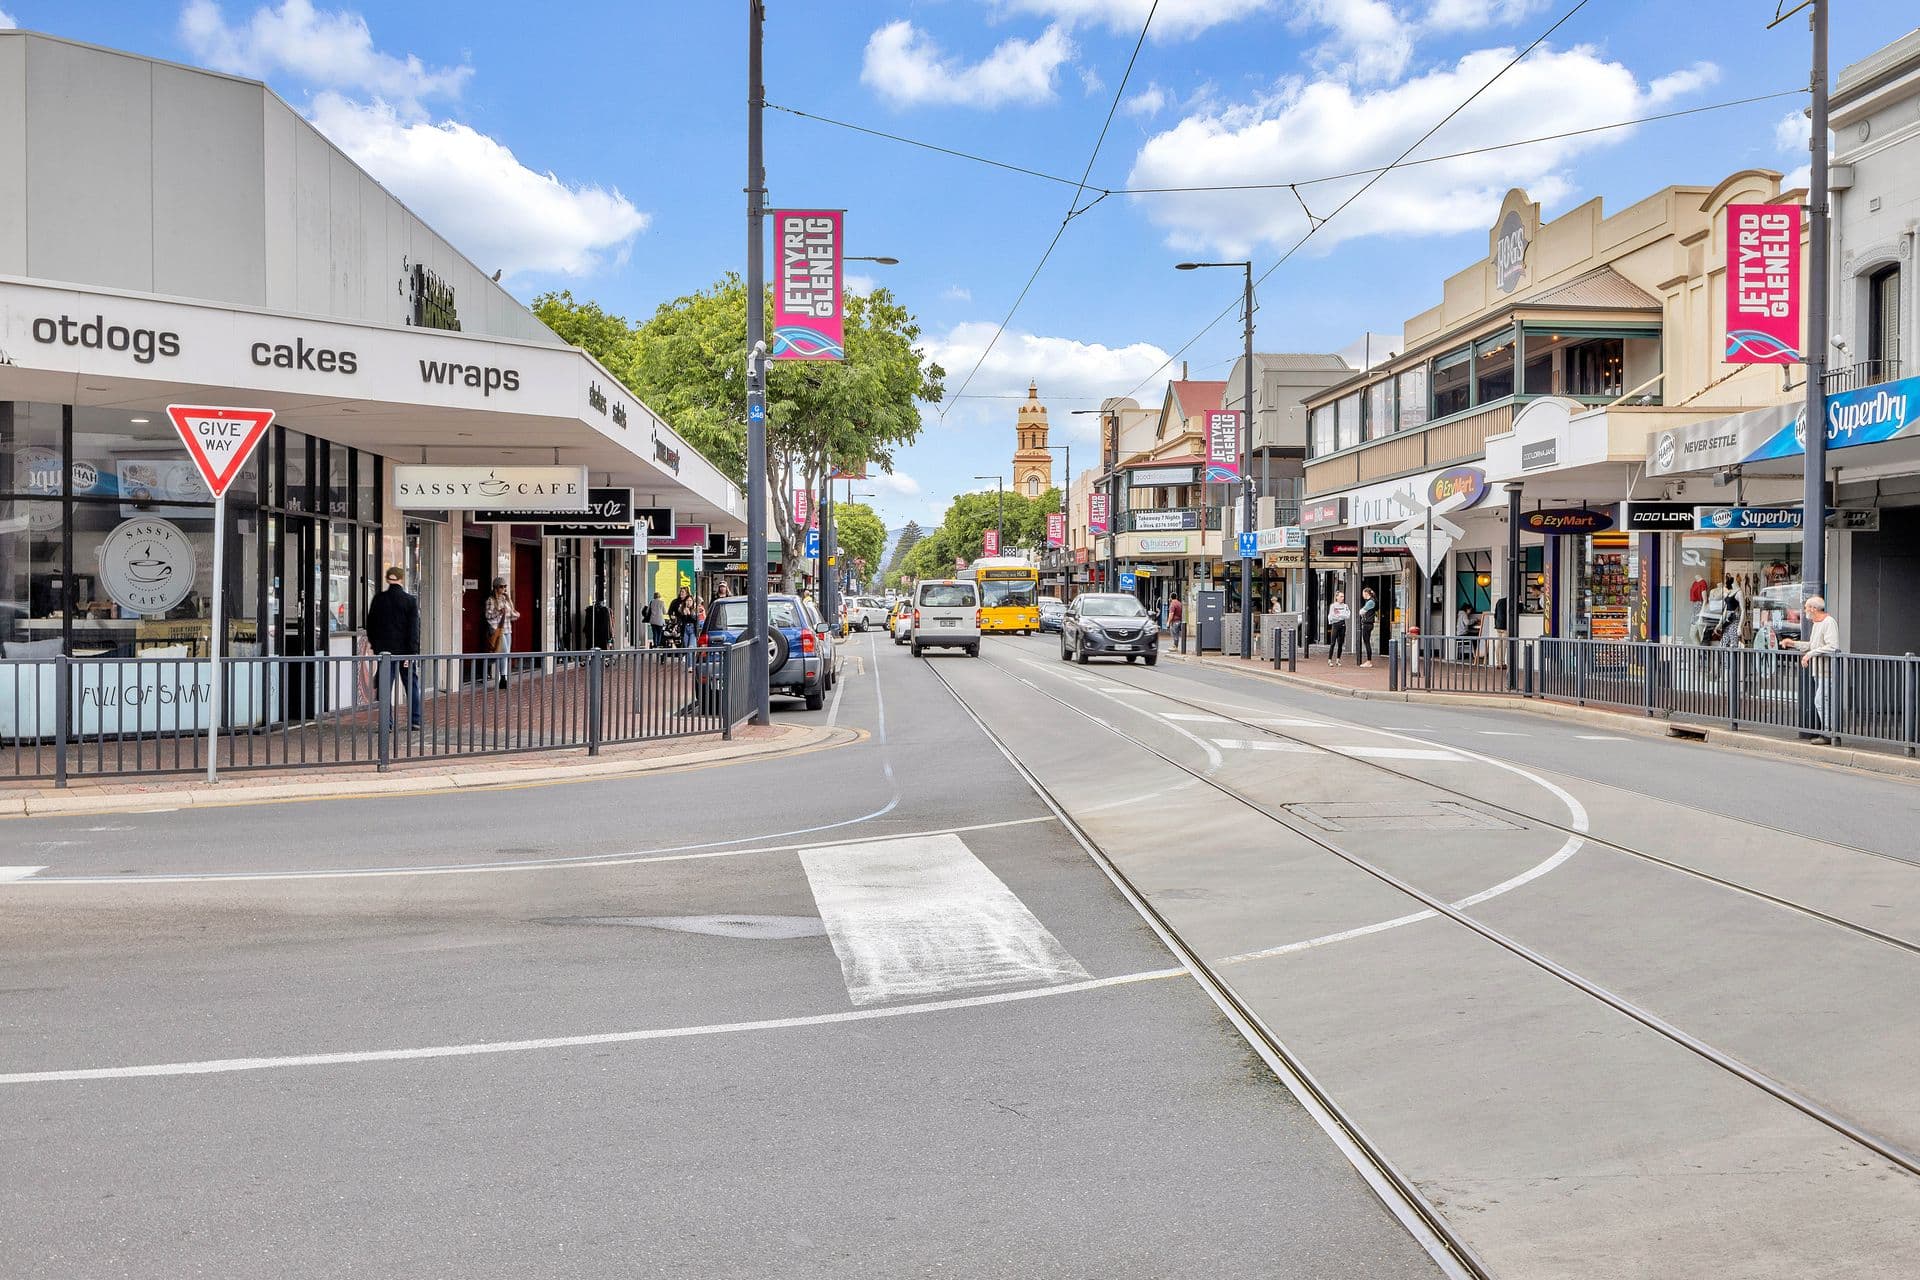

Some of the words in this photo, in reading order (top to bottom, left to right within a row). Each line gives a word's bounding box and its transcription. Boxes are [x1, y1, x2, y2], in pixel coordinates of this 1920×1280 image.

[805, 218, 833, 317] GLENELG
[1761, 214, 1790, 318] GLENELG
[32, 314, 180, 364] otdogs
[250, 336, 358, 375] cakes
[419, 359, 520, 397] wraps
[1828, 390, 1908, 440] SuperDry
[199, 421, 241, 438] GIVE
[206, 439, 232, 451] WAY
[1221, 414, 1236, 463] GLENELG
[1684, 439, 1708, 454] NEVER
[400, 483, 472, 495] SASSY
[517, 482, 577, 495] CAFE
[603, 500, 621, 517] Oz
[1843, 511, 1871, 519] JETTY
[1543, 514, 1594, 527] EzyMart
[1712, 512, 1732, 524] HAHN
[1741, 510, 1801, 527] SuperDry
[1847, 519, 1866, 527] BAR
[126, 526, 173, 541] SASSY
[810, 532, 819, 544] P
[128, 592, 168, 605] CAFE
[124, 685, 153, 706] OF
